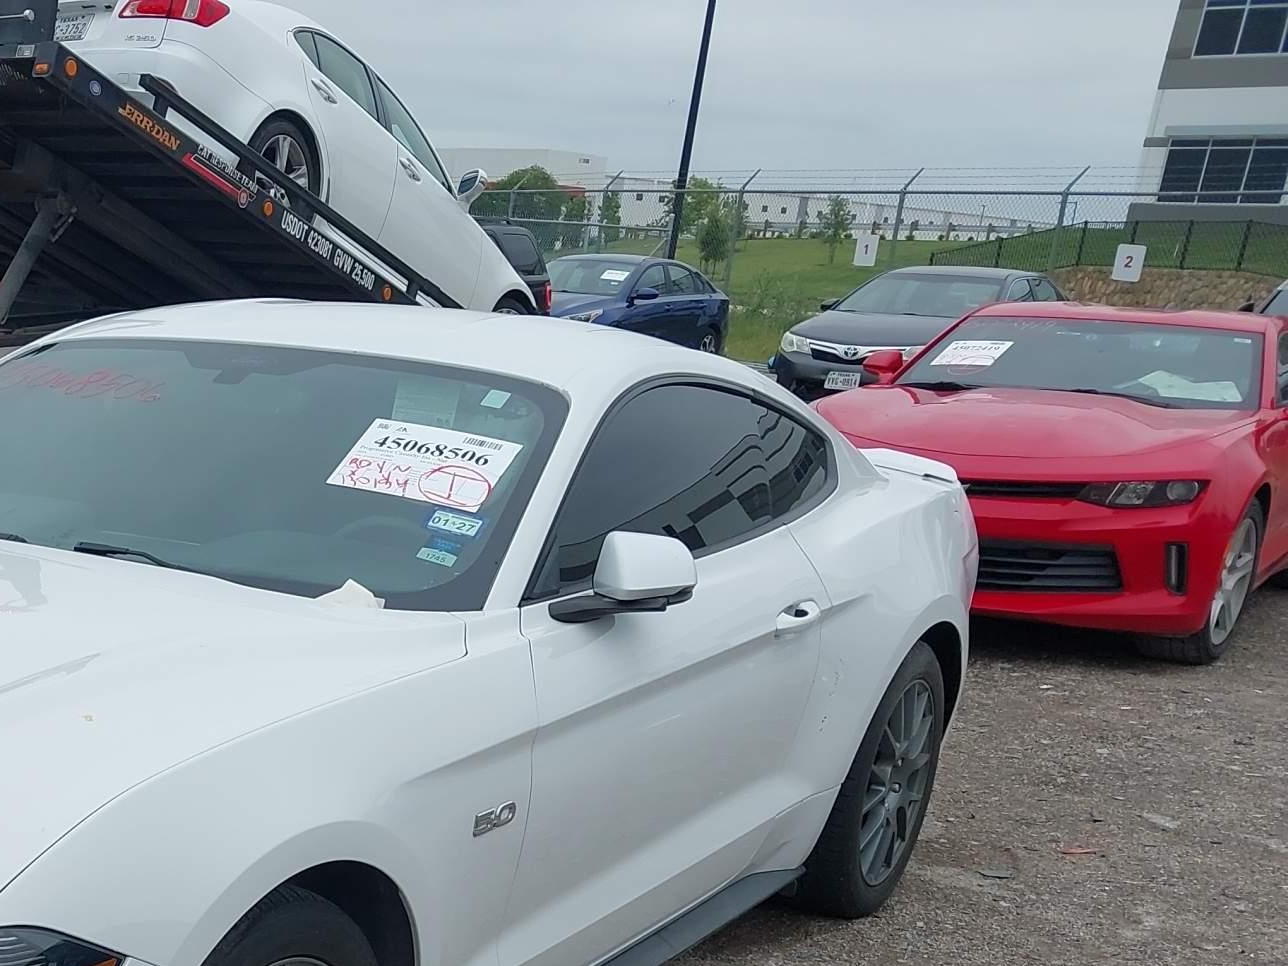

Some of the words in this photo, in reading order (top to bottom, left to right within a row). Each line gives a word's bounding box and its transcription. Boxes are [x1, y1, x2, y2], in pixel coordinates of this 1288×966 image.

[281, 210, 308, 242] USDOT
[307, 230, 333, 260] 423081
[333, 248, 354, 274] GVW
[352, 262, 376, 291] 25,500
[863, 244, 870, 255] 1
[1123, 256, 1134, 269] 2
[374, 435, 494, 467] 45068506
